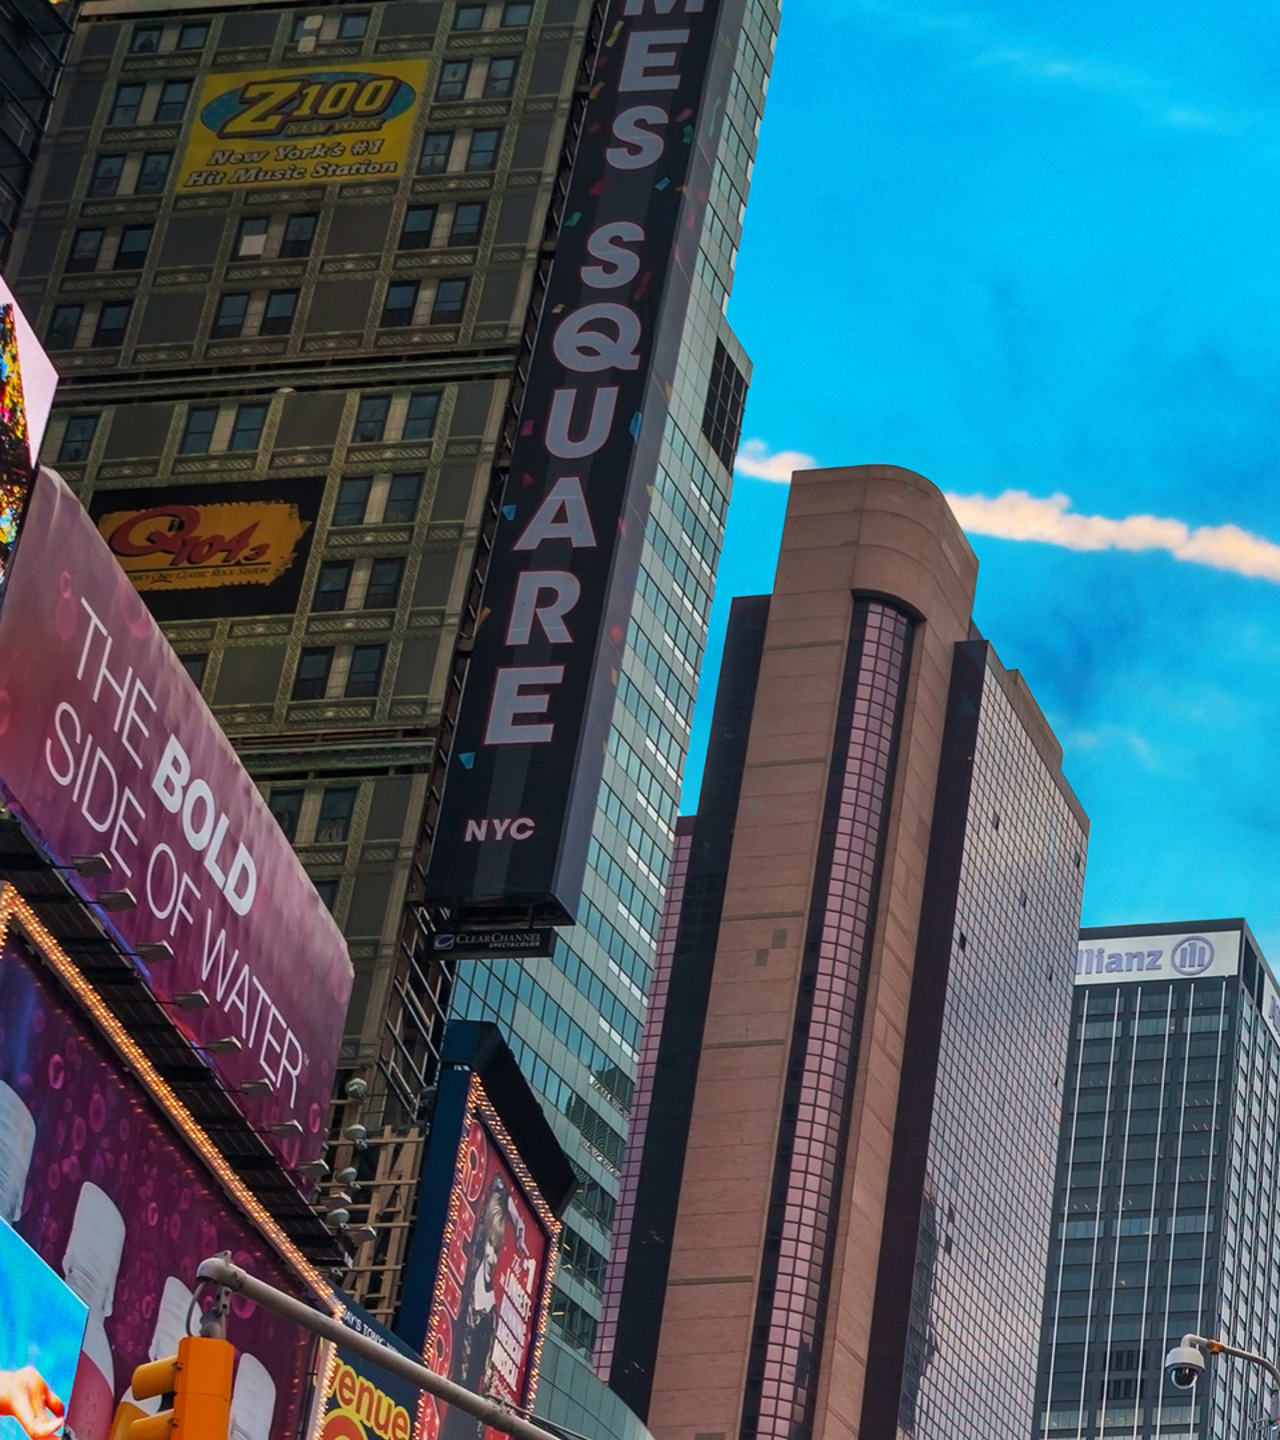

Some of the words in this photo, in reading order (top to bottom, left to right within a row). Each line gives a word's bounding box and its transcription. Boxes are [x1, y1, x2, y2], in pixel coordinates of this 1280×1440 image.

[218, 77, 402, 138] Z100
[606, 0, 702, 170] ES
[184, 170, 226, 188] Hit
[228, 166, 306, 185] Music
[311, 160, 398, 180] Station
[207, 149, 268, 167] New
[274, 142, 346, 162] York's
[350, 139, 386, 156] #1
[484, 221, 646, 745] SQUARE
[77, 596, 157, 770] THE
[151, 734, 257, 916] BOLD
[464, 817, 536, 842] NYC
[46, 701, 146, 877] SIDE
[146, 842, 201, 938] OF
[201, 908, 304, 1109] WATER
